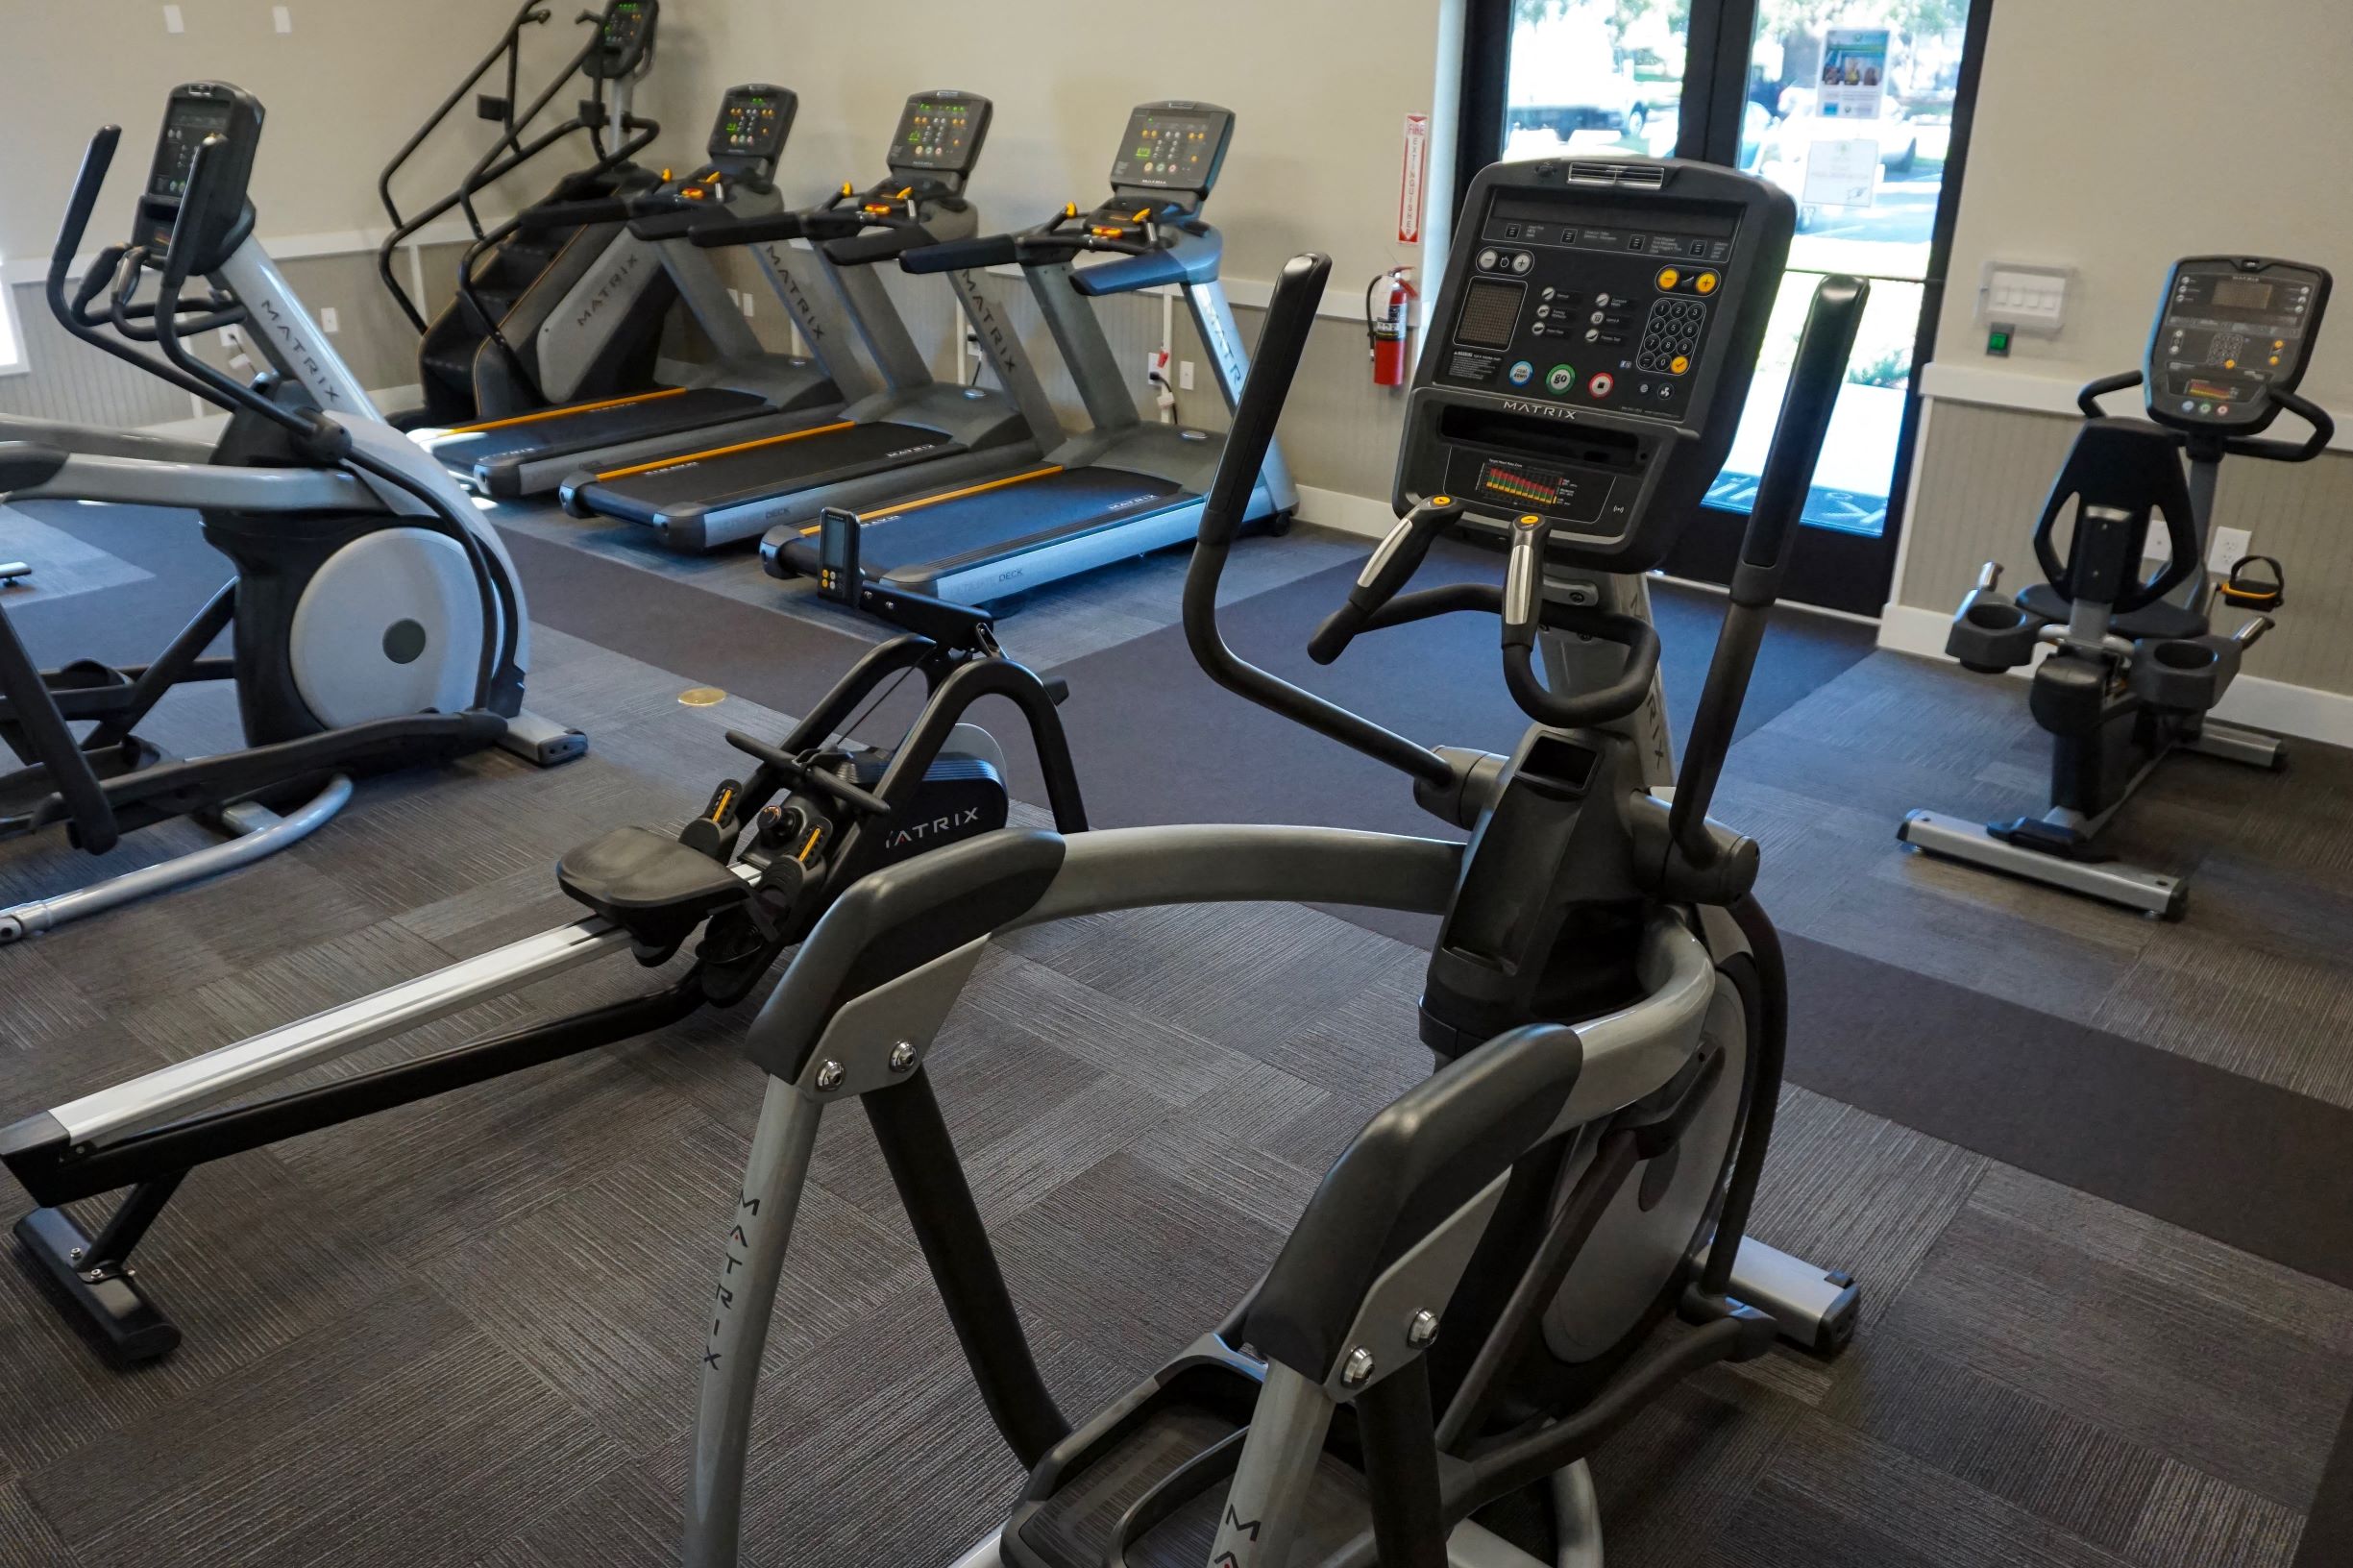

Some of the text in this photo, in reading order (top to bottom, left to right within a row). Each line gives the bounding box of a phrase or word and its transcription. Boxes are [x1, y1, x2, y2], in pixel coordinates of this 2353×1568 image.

[1409, 124, 1425, 135] FIRE
[576, 255, 638, 327] MATRIX
[766, 245, 824, 339] MATRIX
[962, 269, 1016, 373] MATRIX
[261, 299, 340, 402] MATRIX
[1554, 374, 1567, 384] go
[1504, 401, 1576, 420] MATRIX
[998, 568, 1023, 582] DECK
[703, 1188, 760, 1371] MATRIX
